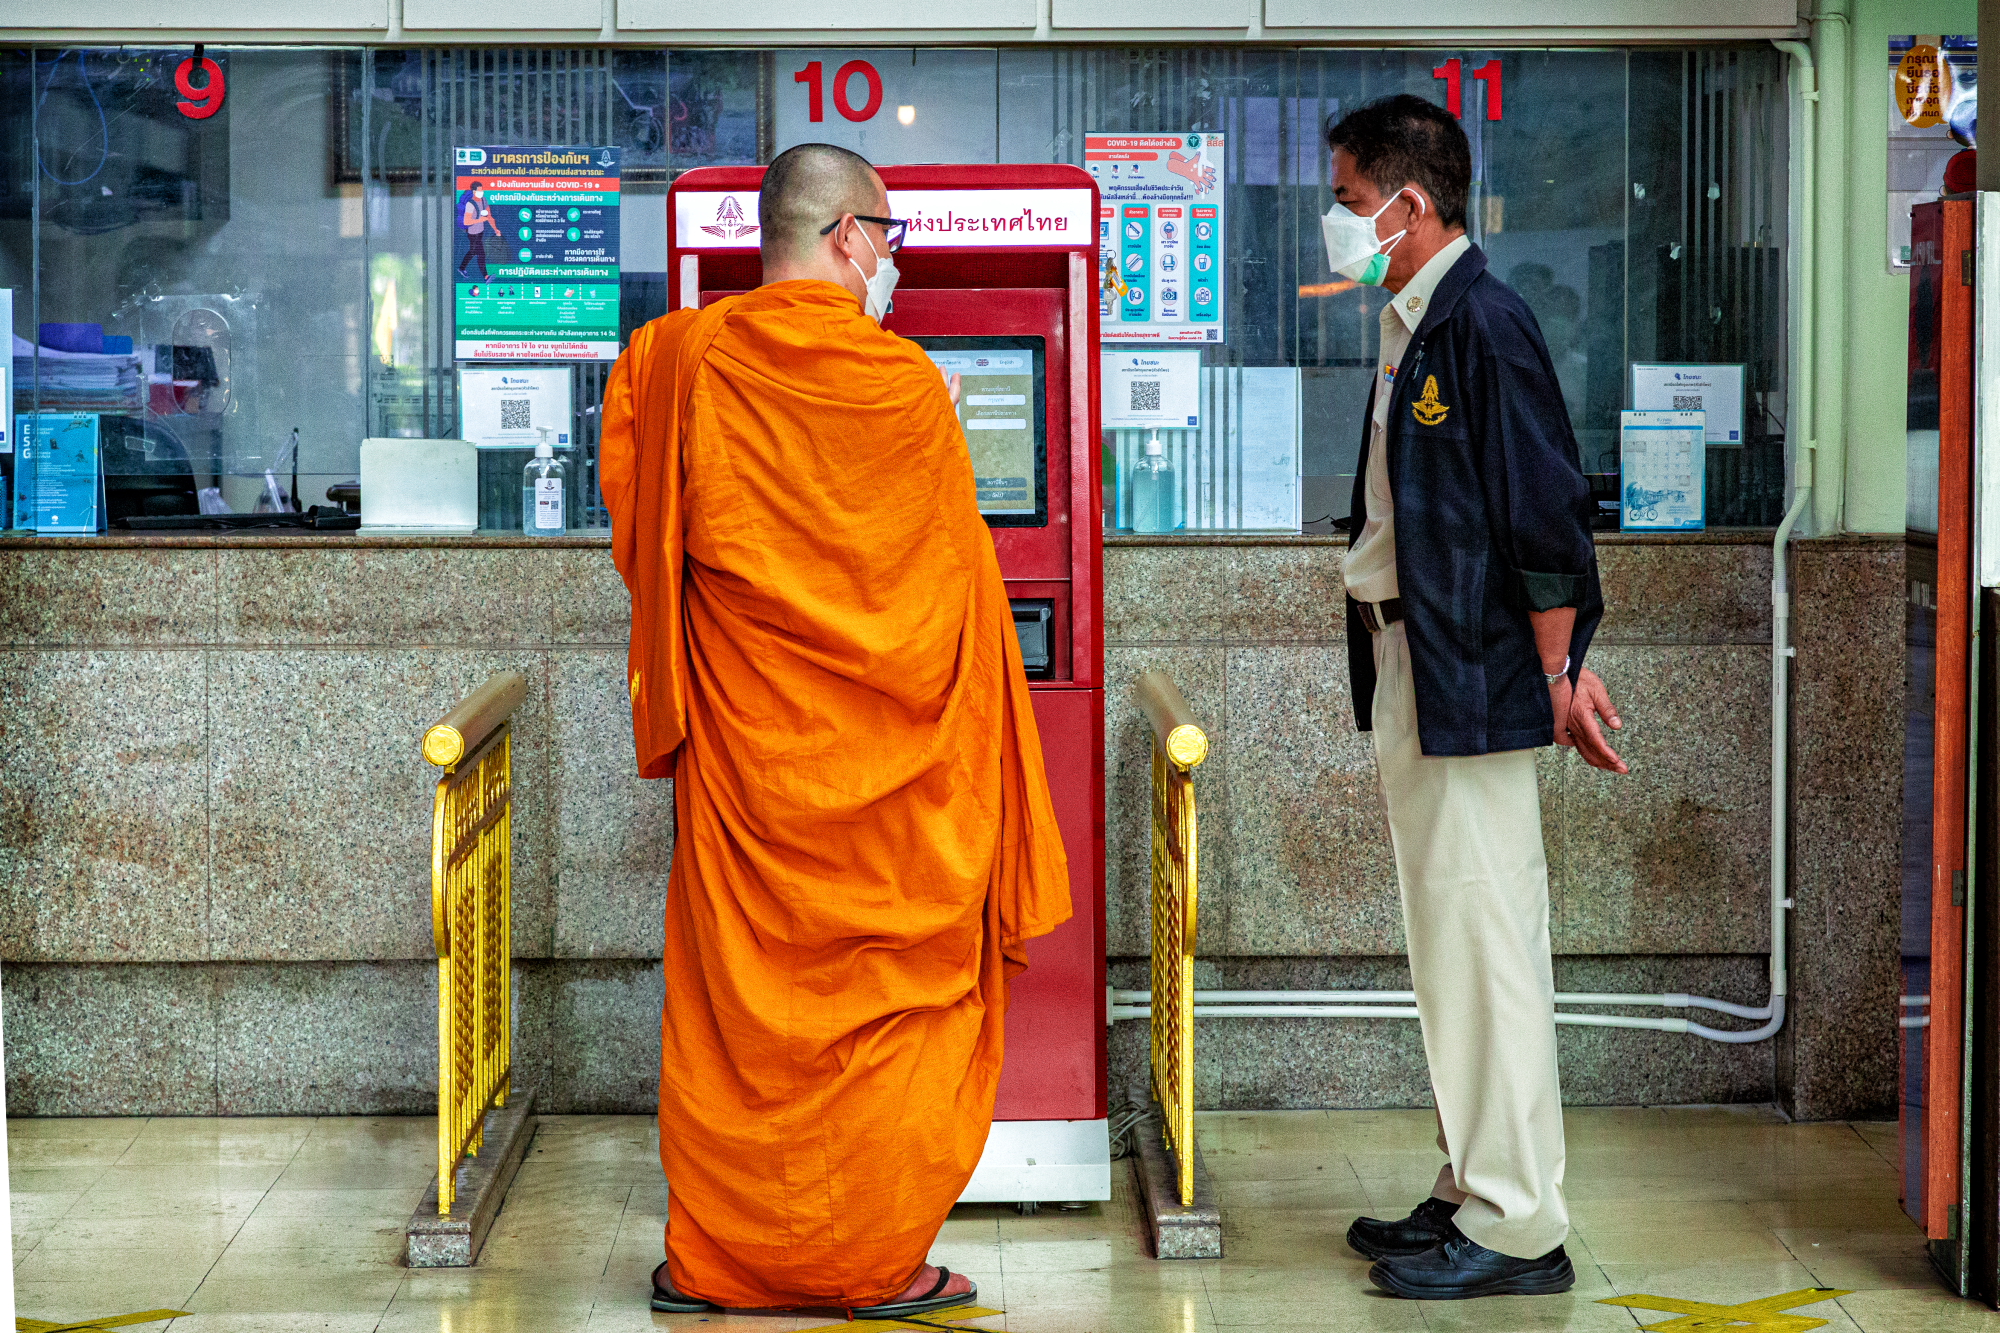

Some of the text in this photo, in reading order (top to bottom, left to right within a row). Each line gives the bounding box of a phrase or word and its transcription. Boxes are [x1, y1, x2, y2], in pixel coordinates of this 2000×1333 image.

[174, 56, 226, 119] 9
[794, 60, 883, 122] 10
[1433, 58, 1502, 120] 11
[1139, 139, 1177, 148] ติดได้อย่างไร
[492, 151, 590, 165] มาตรการป้องกันฯ
[496, 179, 593, 189] ป้องกันความเสี่ยง COVID-19
[489, 193, 603, 204] อุปกรณ์ป้องกันระหว่างการเดินทาง
[904, 208, 1068, 232] ห่งประเทศไทย
[564, 248, 605, 256] หากมีอาการไข้
[23, 424, 31, 435] E
[23, 436, 31, 447] S
[23, 448, 31, 459] G
